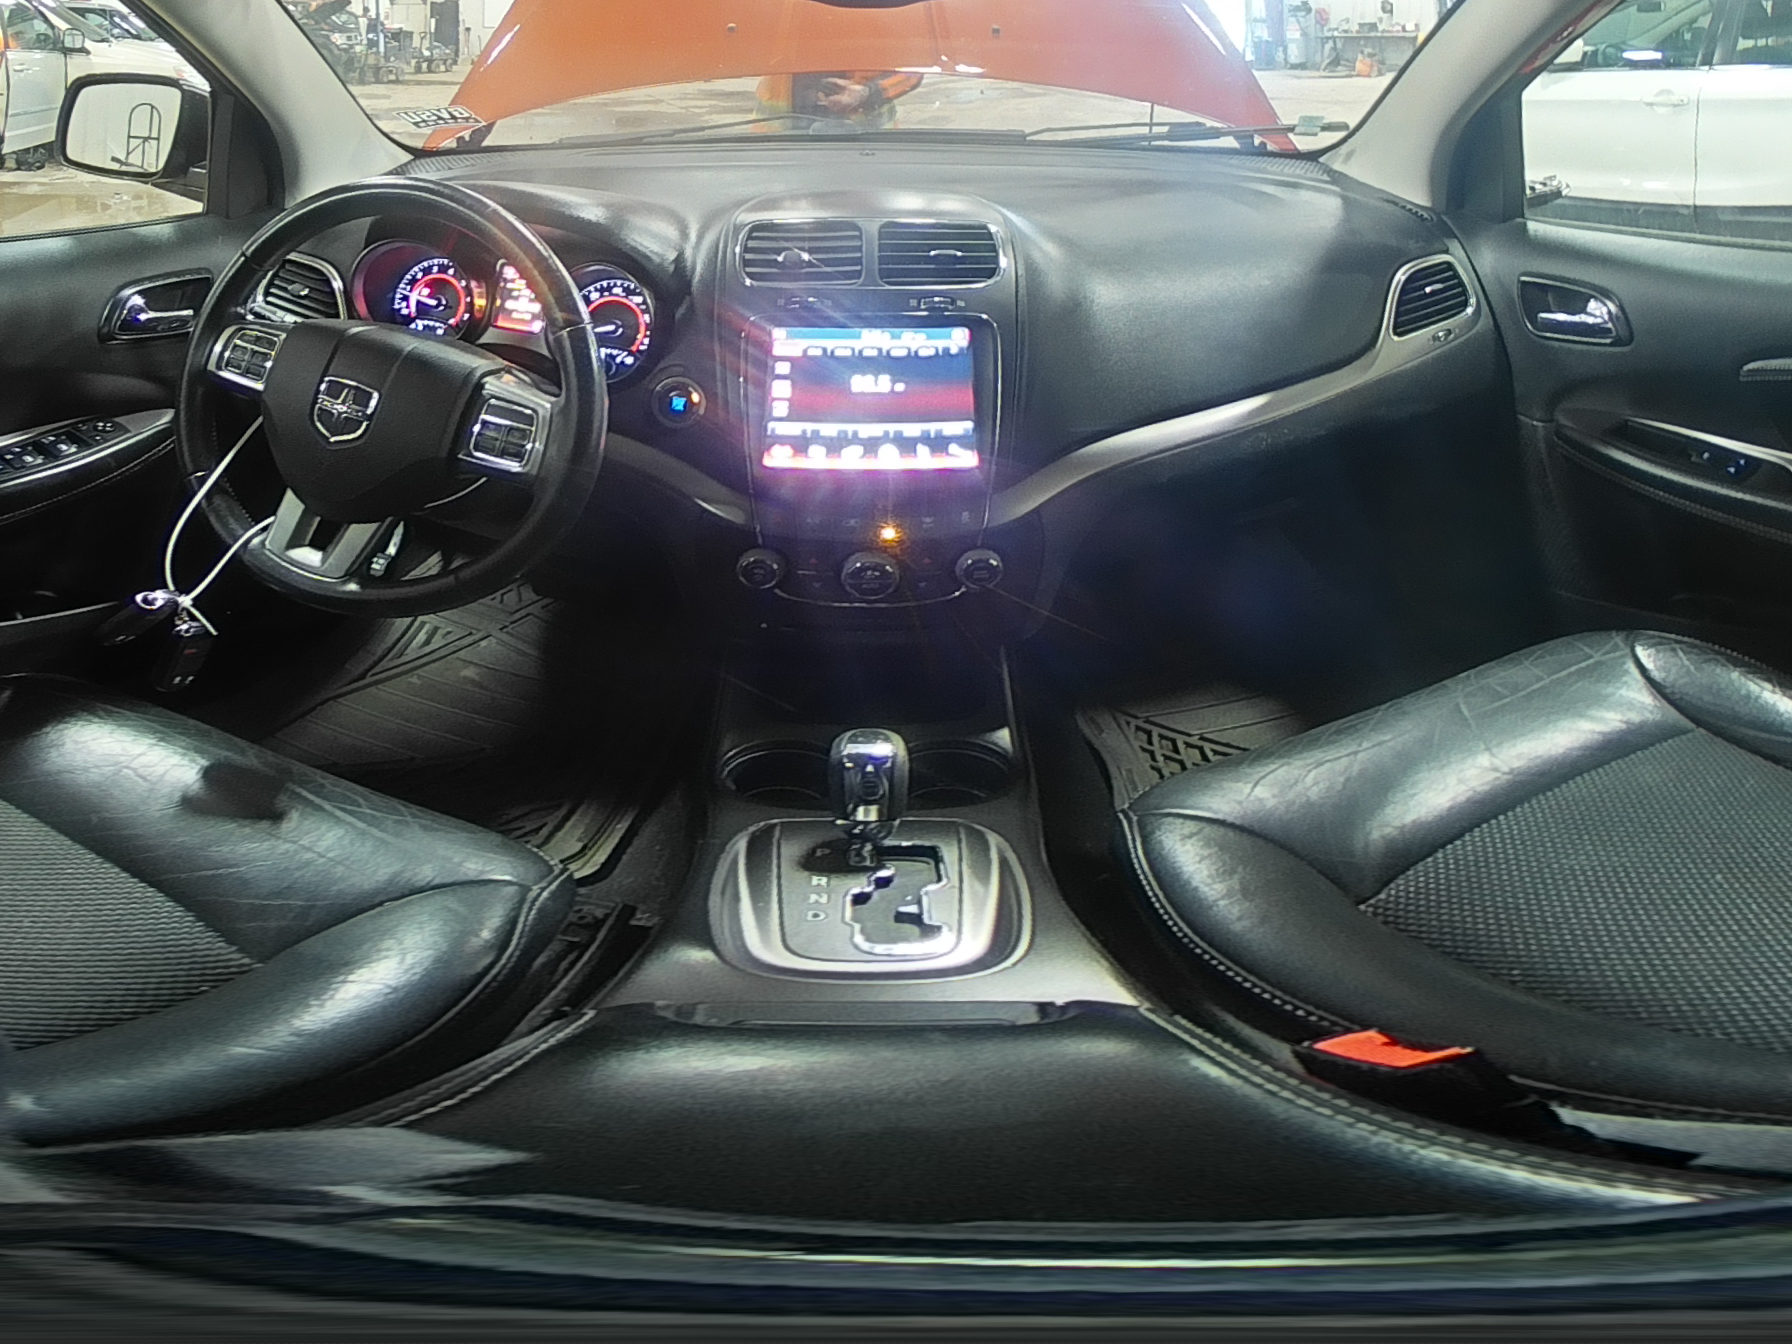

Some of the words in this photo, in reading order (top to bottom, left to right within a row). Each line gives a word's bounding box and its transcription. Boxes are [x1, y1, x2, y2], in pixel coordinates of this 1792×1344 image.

[811, 875, 828, 887] R
[809, 892, 828, 904] N
[807, 910, 827, 921] D
